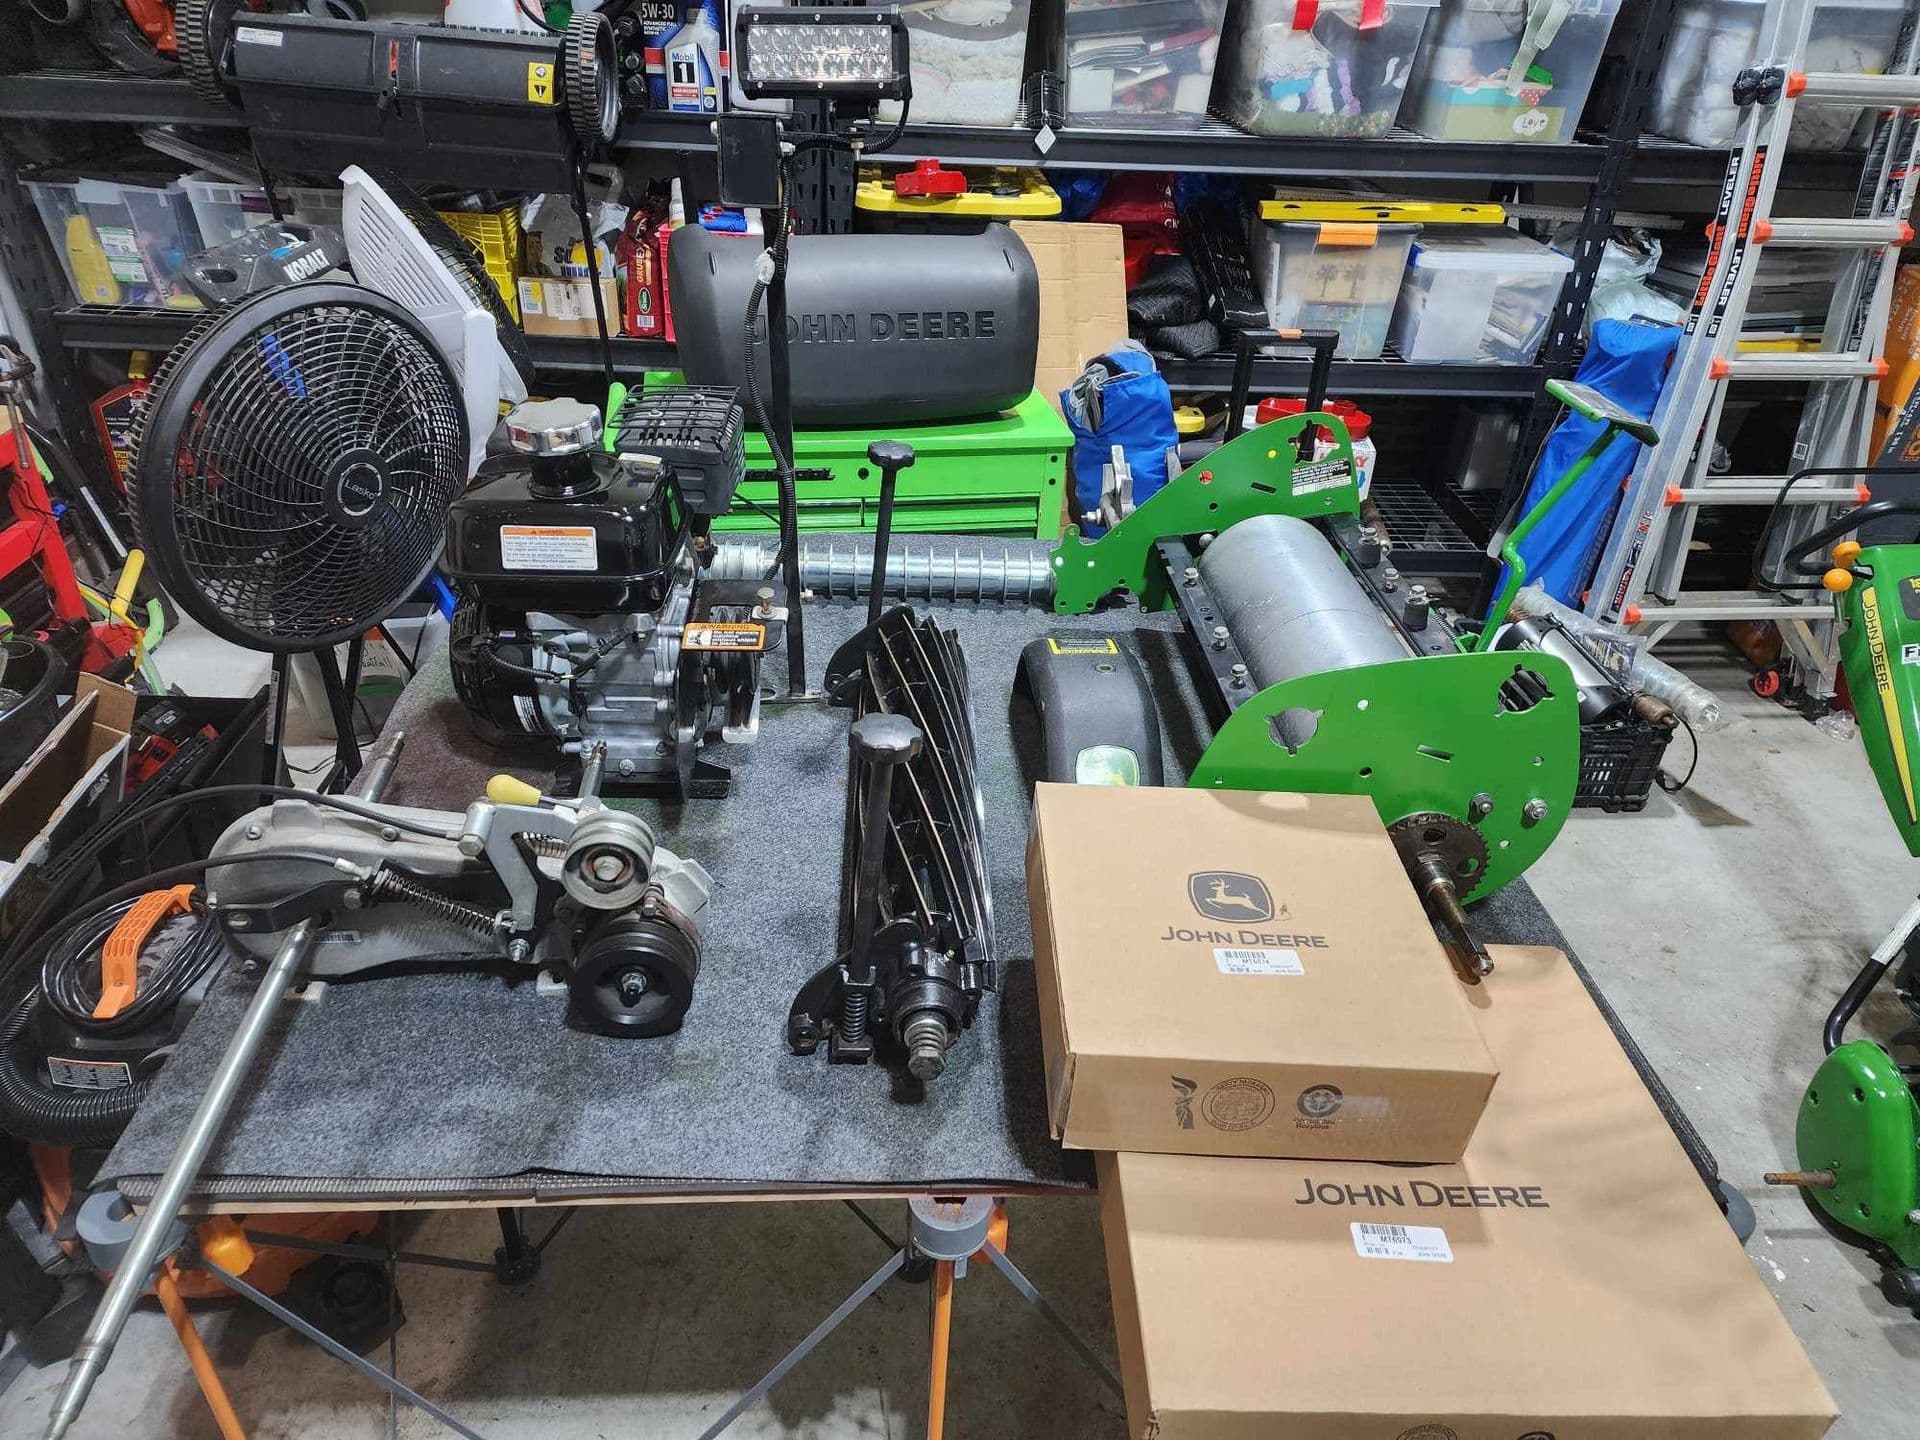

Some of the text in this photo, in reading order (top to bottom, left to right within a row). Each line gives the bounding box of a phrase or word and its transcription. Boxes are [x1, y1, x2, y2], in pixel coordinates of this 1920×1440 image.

[641, 2, 675, 19] 5W-30
[671, 52, 695, 61] Mobil
[678, 62, 688, 83] 1
[1722, 157, 1740, 215] LEVELER
[283, 248, 331, 282] KOBALT
[1719, 249, 1743, 305] LEVELER
[870, 311, 996, 342] DEERE
[345, 479, 375, 500] Lasko
[1864, 603, 1890, 693] JOHN DEERE
[1161, 926, 1329, 948] JOHN DEERE
[1295, 1178, 1550, 1208] JOHN DEERE
